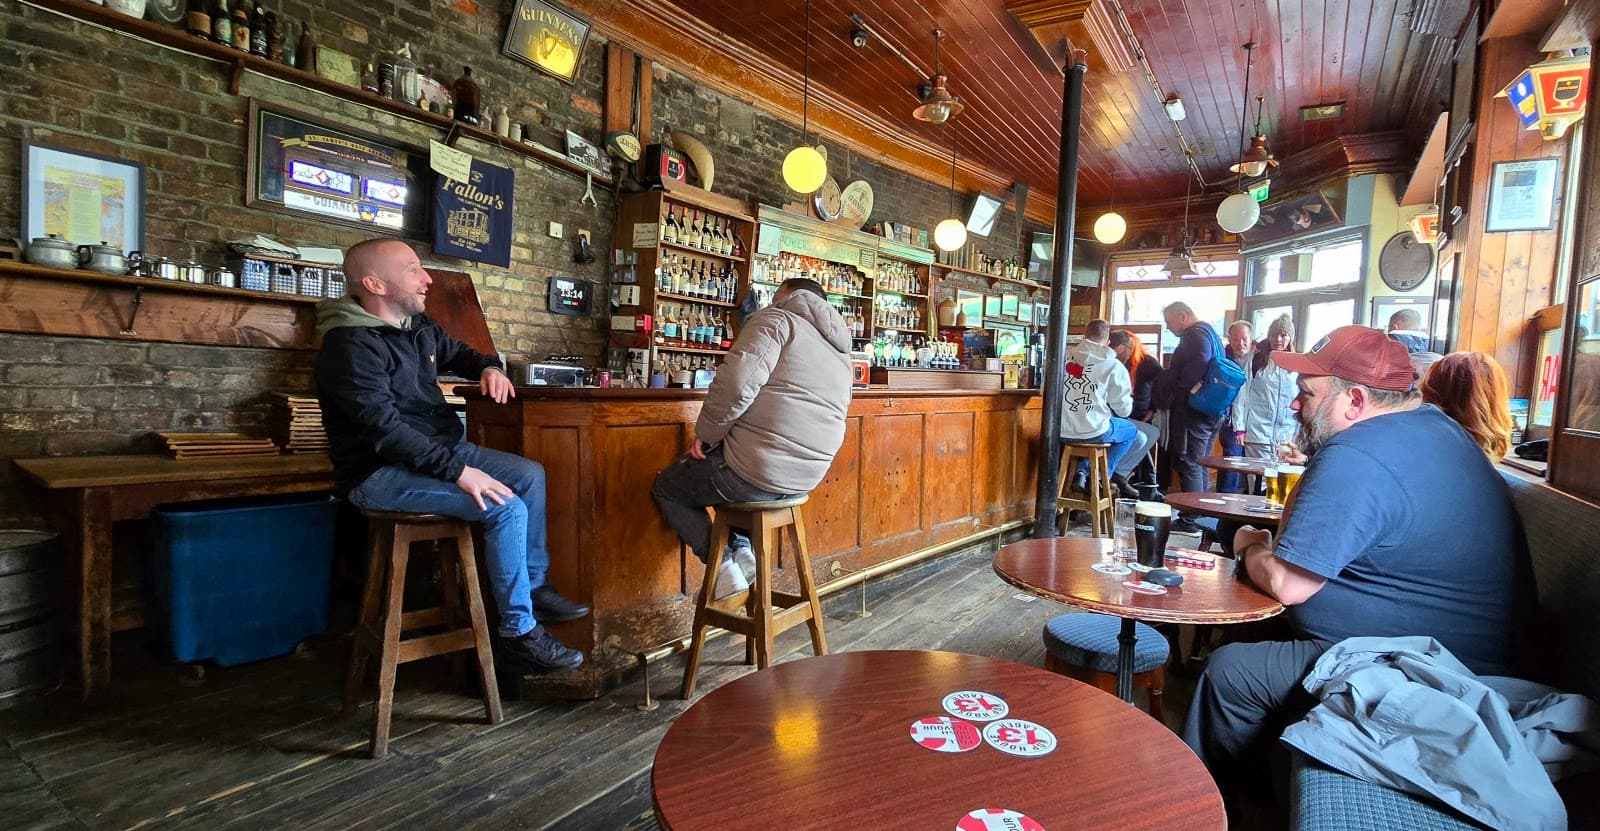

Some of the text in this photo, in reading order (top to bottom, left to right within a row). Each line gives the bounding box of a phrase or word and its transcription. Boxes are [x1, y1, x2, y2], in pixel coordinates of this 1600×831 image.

[521, 8, 579, 46] GUINNESS
[560, 289, 583, 300] 13:14
[951, 692, 984, 701] LAGER
[952, 706, 991, 718] HOUSE
[954, 697, 994, 713] 13
[1000, 723, 1037, 731] LAGER
[990, 734, 1027, 752] HOUSE
[997, 728, 1042, 745] 13
